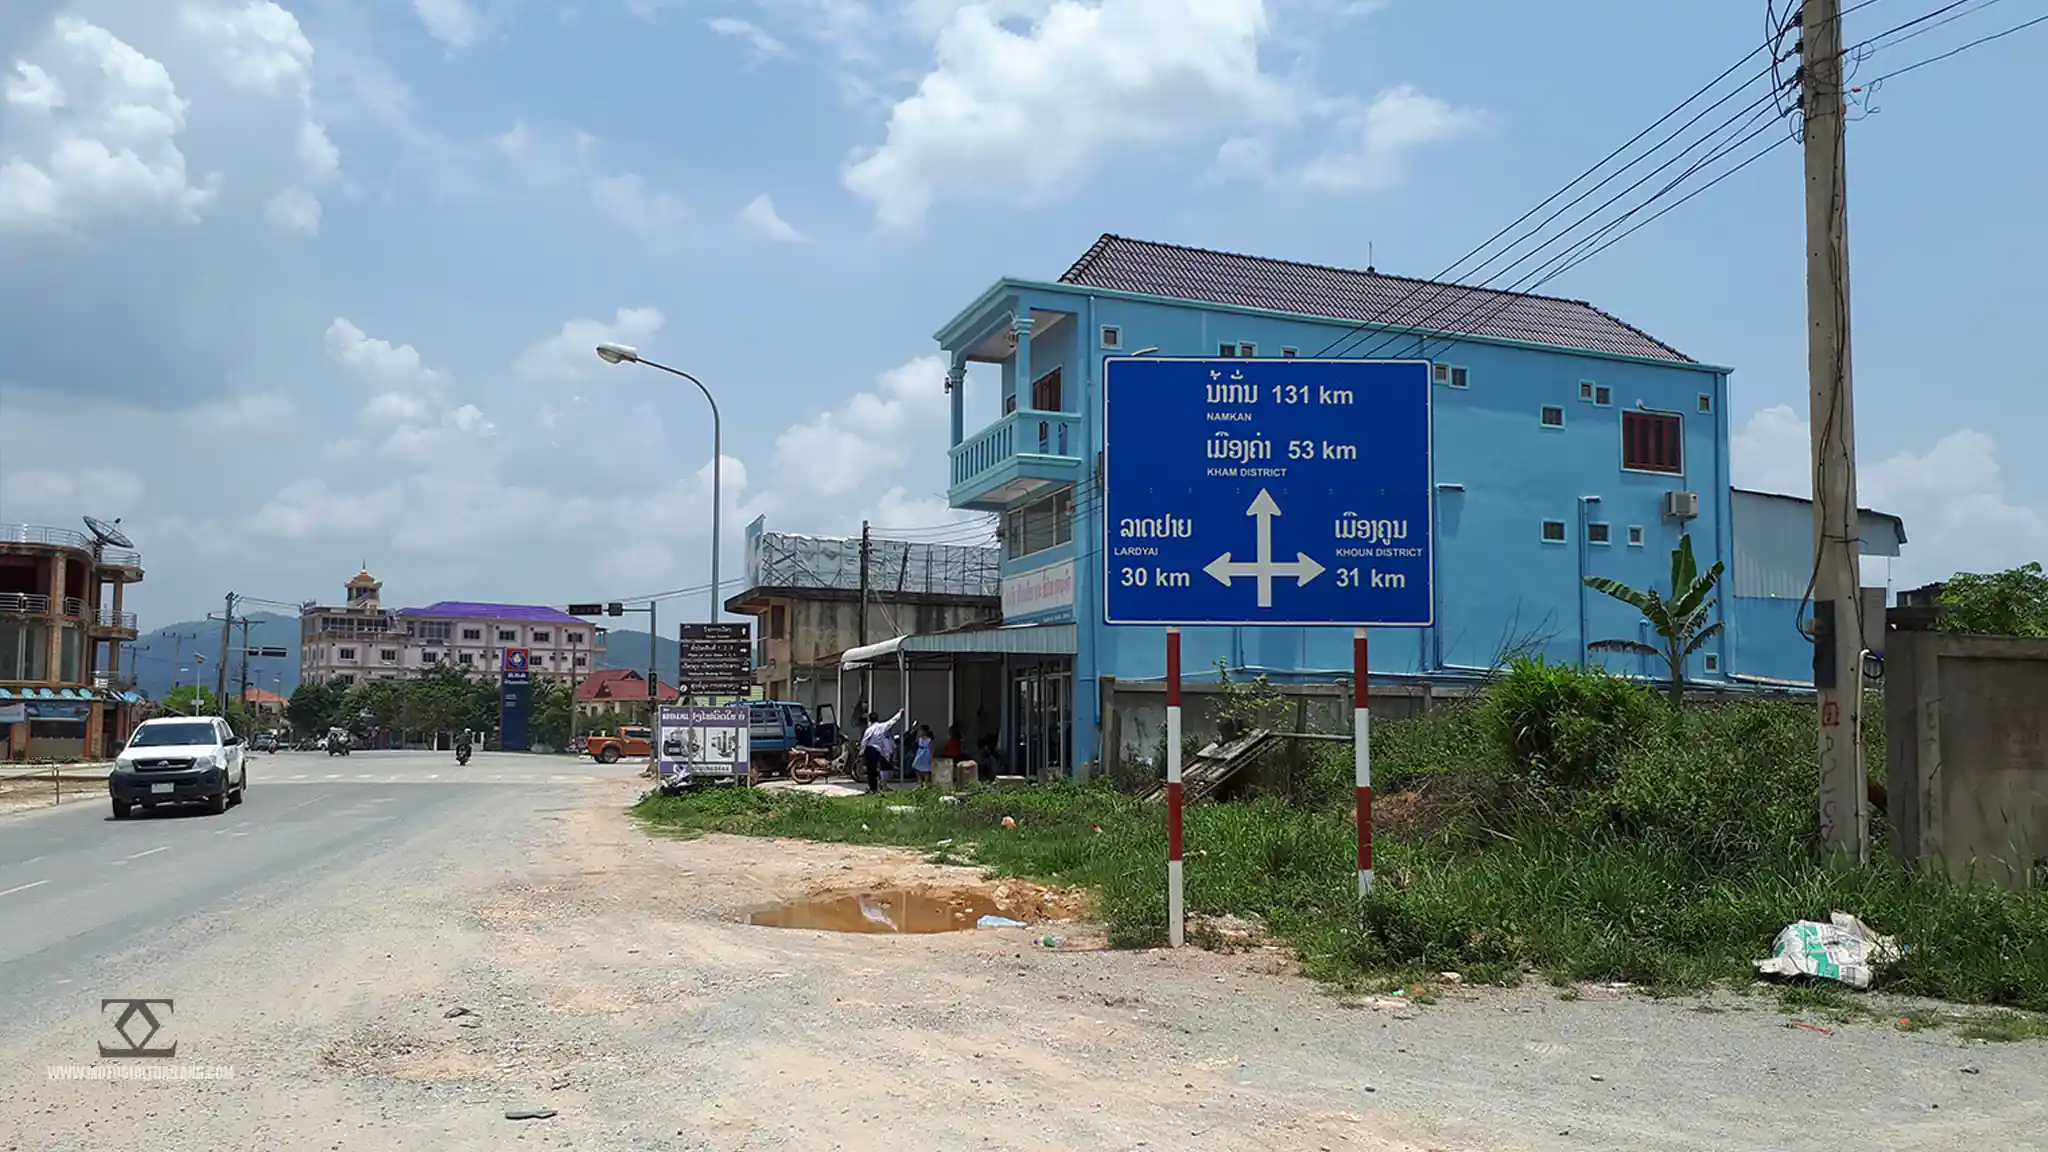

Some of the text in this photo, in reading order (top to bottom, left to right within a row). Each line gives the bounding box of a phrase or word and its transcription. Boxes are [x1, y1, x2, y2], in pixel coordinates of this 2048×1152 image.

[1271, 384, 1309, 404] 131
[1319, 385, 1354, 405] km
[1206, 412, 1252, 421] NAMKAN
[1288, 440, 1314, 460] 53
[1322, 440, 1357, 460] km
[1206, 468, 1287, 477] KHAM DISTRICT
[1114, 547, 1158, 556] LARDYAI
[1335, 548, 1423, 557] KHOUN DISTRICT
[1120, 567, 1190, 587] 30 km
[1335, 567, 1405, 588] 31 km
